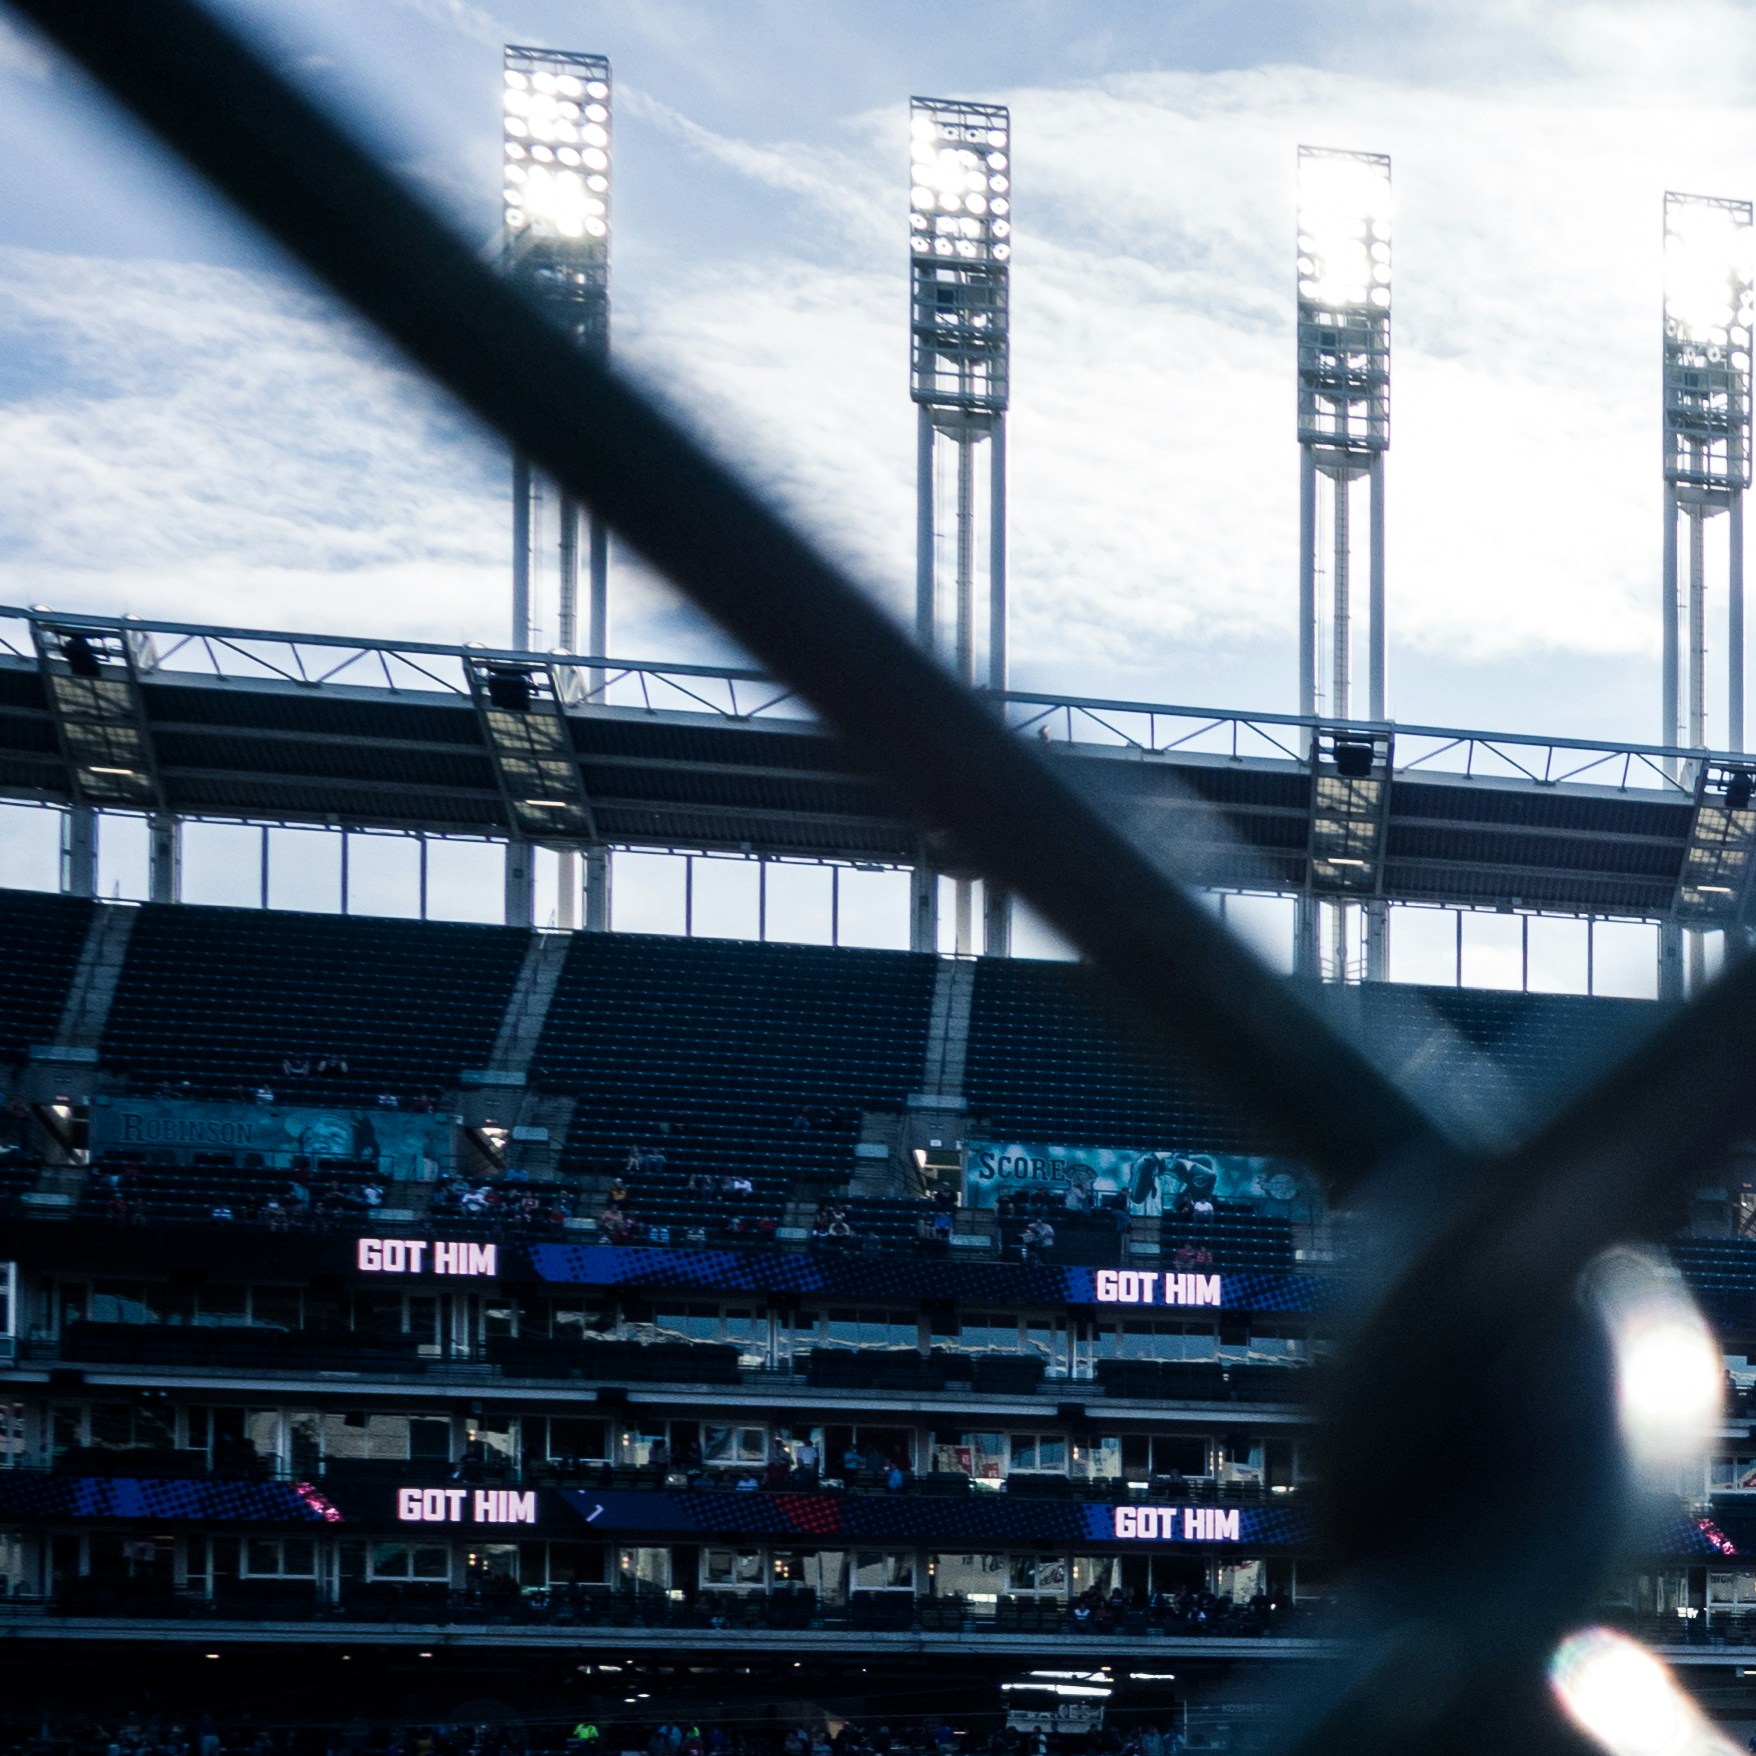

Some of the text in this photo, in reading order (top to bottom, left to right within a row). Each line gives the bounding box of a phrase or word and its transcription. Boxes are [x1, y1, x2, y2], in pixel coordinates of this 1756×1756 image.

[119, 1111, 254, 1145] ROBINSON
[979, 1152, 1066, 1183] SCORE
[358, 1238, 498, 1276] GOT HIM
[1096, 1270, 1222, 1306] GOT HIM
[398, 1488, 536, 1524] GOT HIM
[1115, 1506, 1240, 1541] GOT HIM
